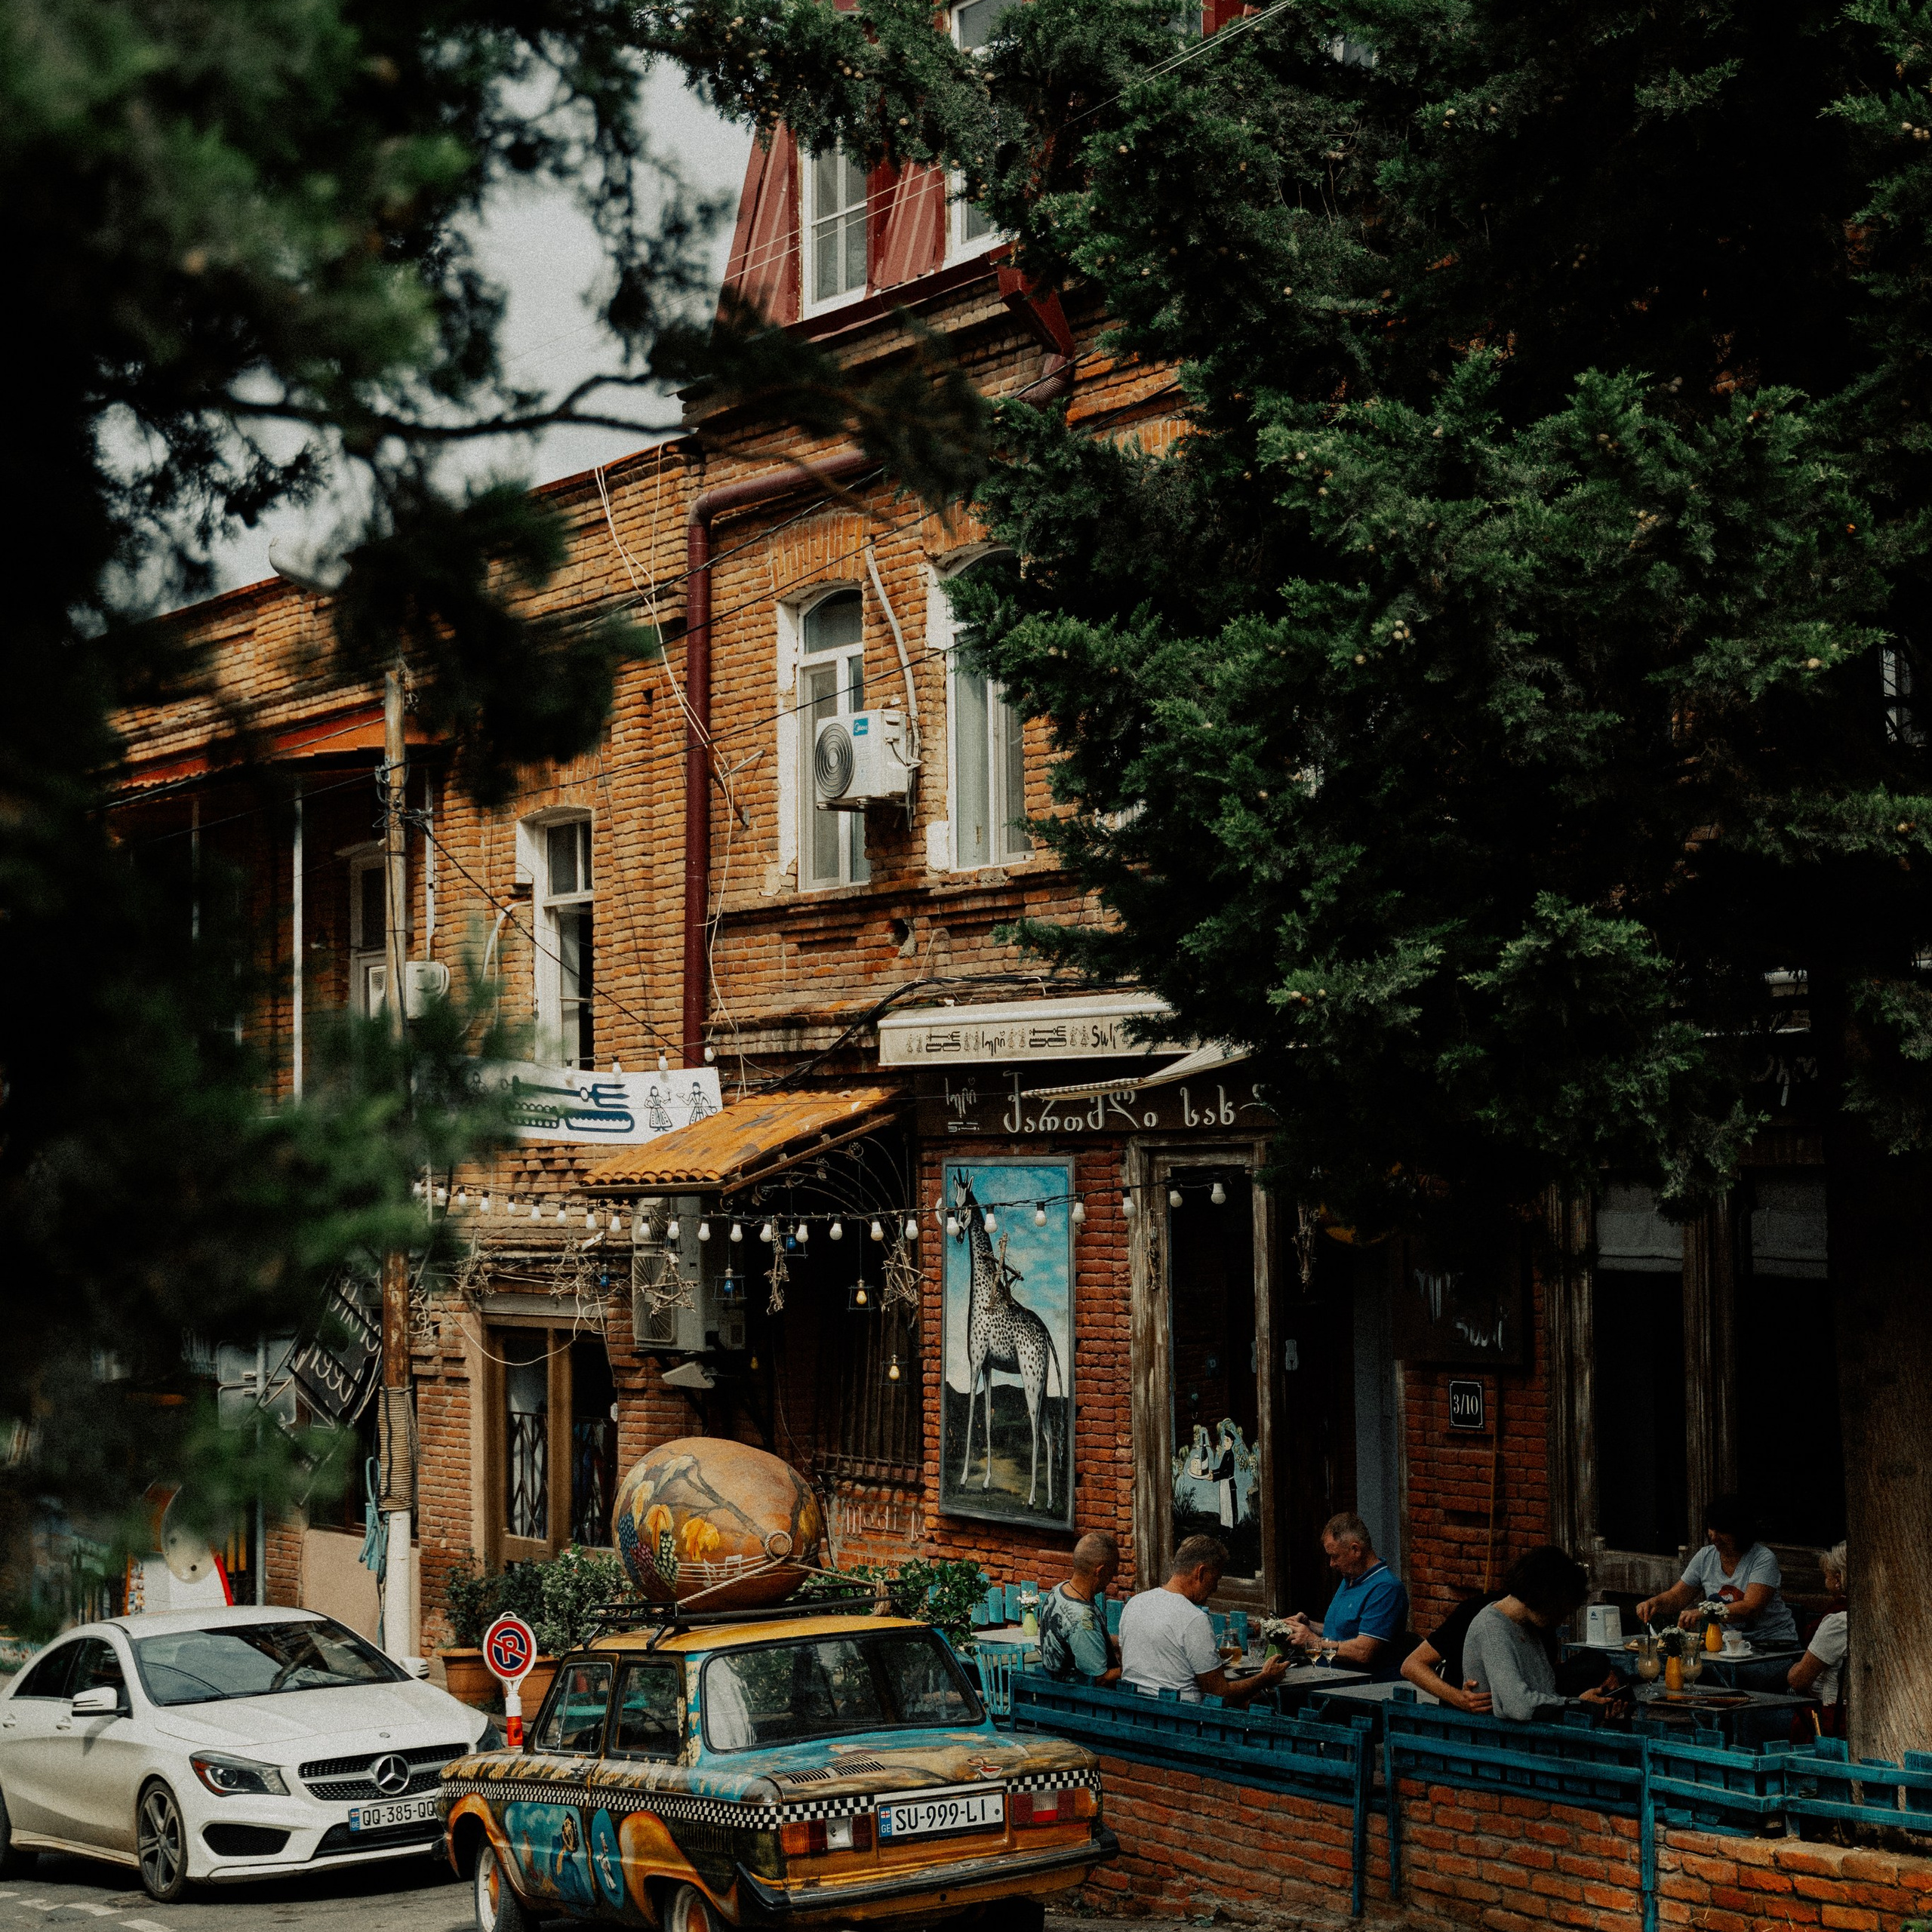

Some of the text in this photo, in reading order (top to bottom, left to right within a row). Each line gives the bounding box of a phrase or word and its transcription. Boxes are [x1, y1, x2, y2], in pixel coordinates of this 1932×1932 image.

[1453, 1393, 1479, 1415] 3/10
[362, 1800, 435, 1826] QQ-385-QQ
[895, 1798, 986, 1832] SU-999-LI
[351, 1820, 360, 1829] GE
[881, 1823, 892, 1833] GE
